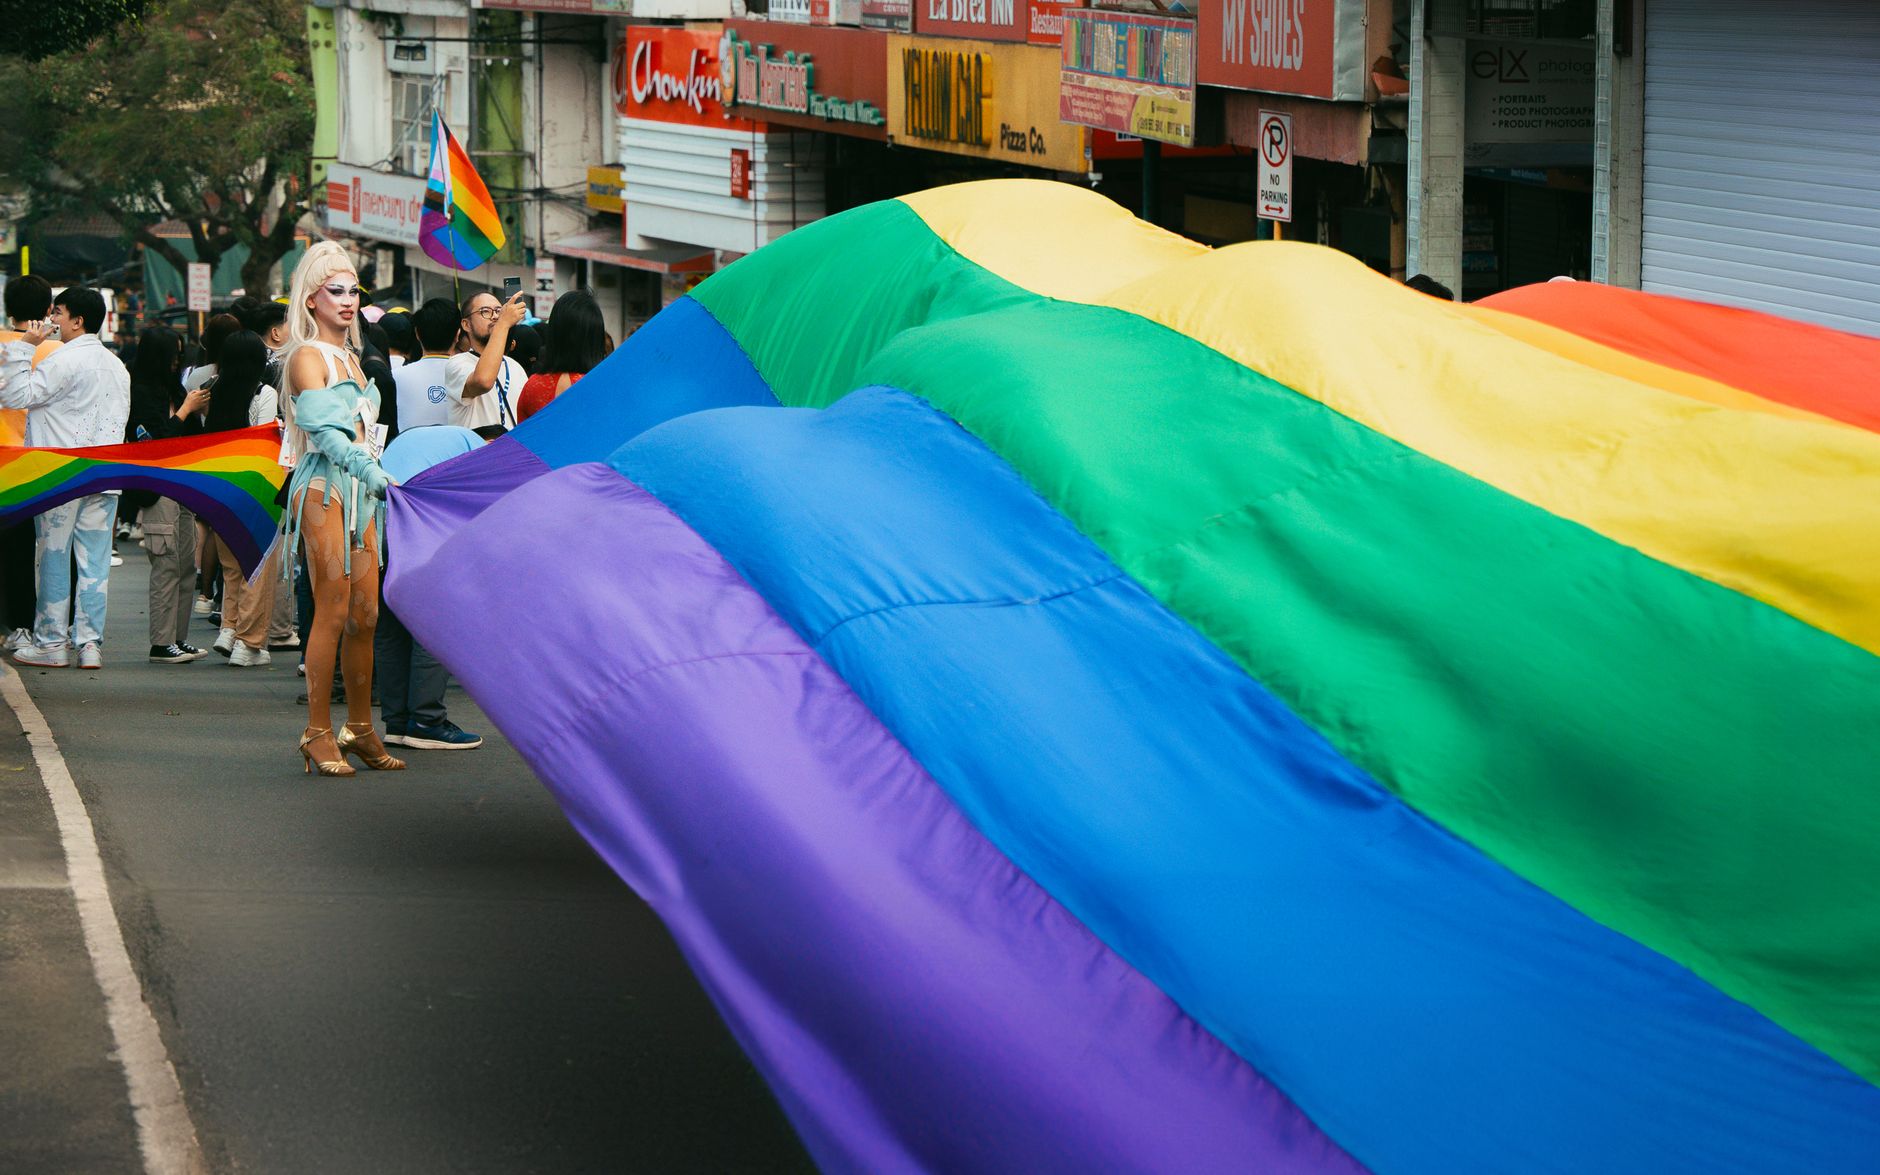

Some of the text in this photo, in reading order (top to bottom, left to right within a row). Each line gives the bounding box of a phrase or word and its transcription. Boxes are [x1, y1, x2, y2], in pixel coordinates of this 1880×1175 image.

[1031, 6, 1063, 35] Restau
[1222, 0, 1304, 71] MY SHOES
[631, 40, 729, 118] Chowkin
[1499, 95, 1546, 104] PORTRAITS
[1499, 107, 1526, 116] FOOD
[1499, 119, 1542, 129] PRODUCT
[1001, 122, 1047, 154] Pizza Co.
[1269, 174, 1280, 186] NO
[1260, 189, 1288, 204] PARKING
[361, 191, 406, 227] mercury
